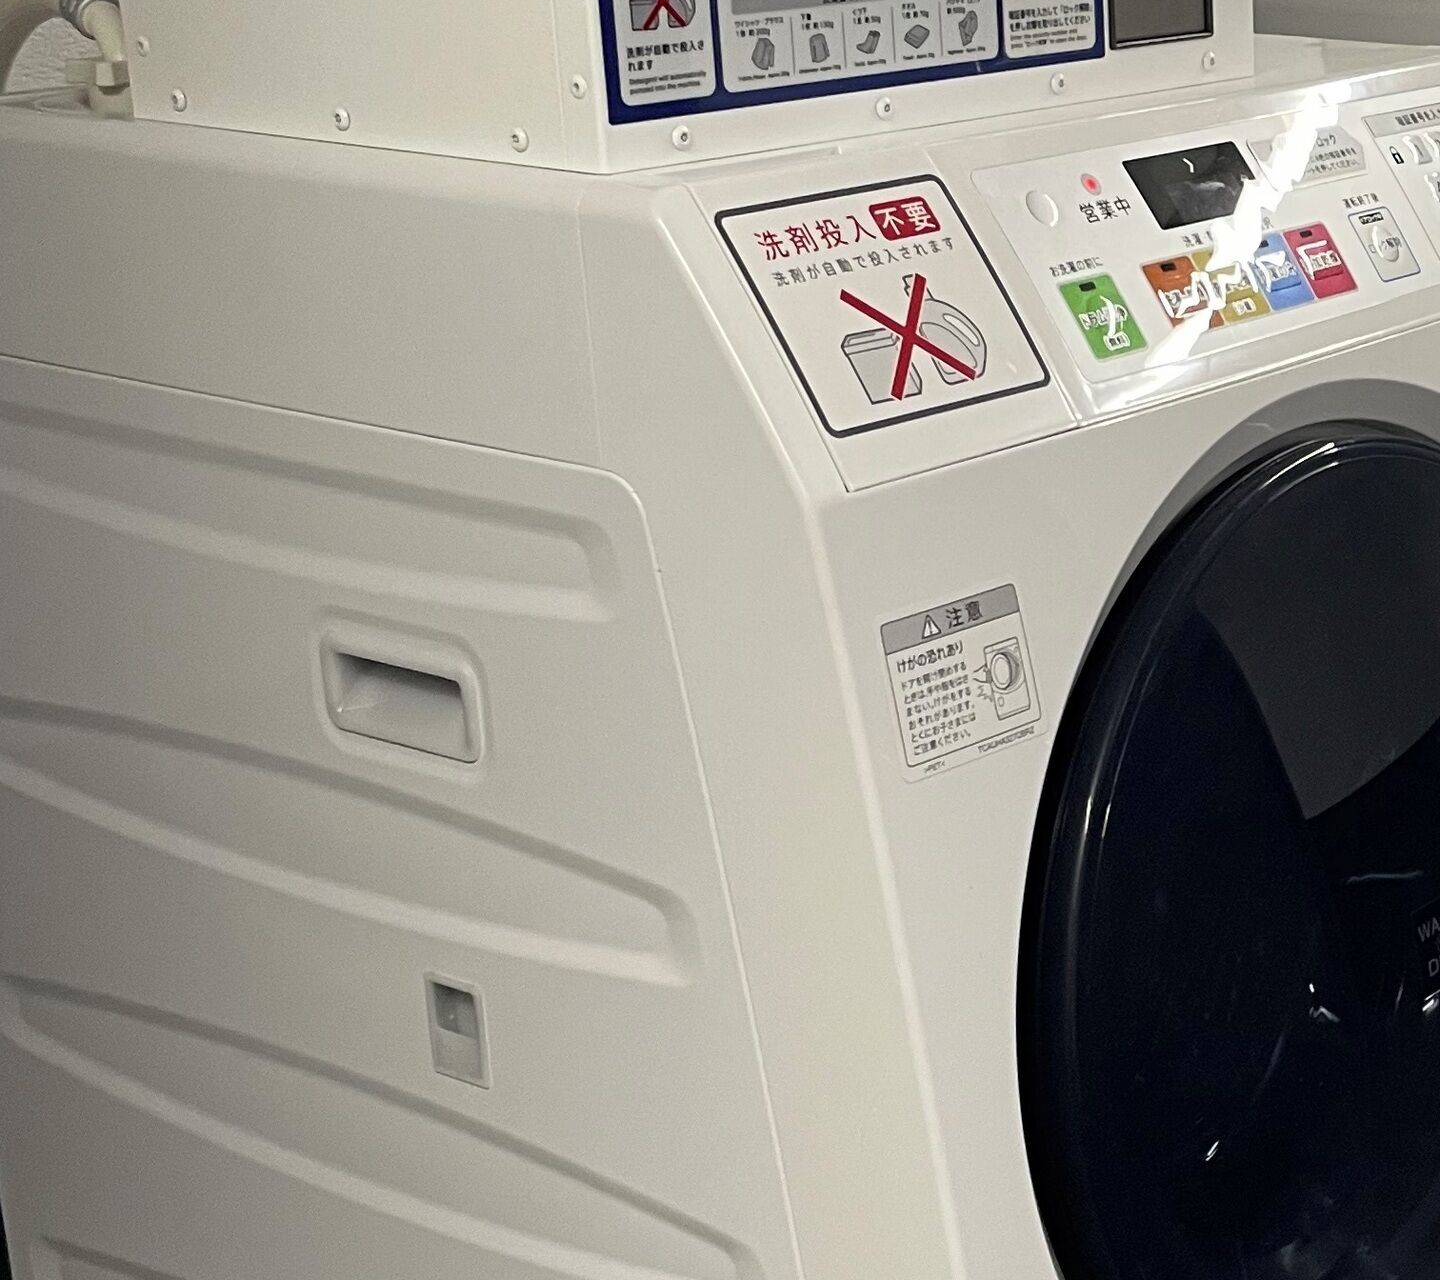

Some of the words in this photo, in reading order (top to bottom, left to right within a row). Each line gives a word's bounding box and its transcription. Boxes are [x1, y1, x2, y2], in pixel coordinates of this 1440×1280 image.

[1079, 195, 1131, 224] 営業中
[754, 215, 877, 261] 洗剤投入
[873, 200, 936, 236] 不要
[772, 237, 954, 287] 洗剤が自動で投入されます
[945, 601, 984, 629] 注意
[896, 639, 964, 674] けがの恐れあり
